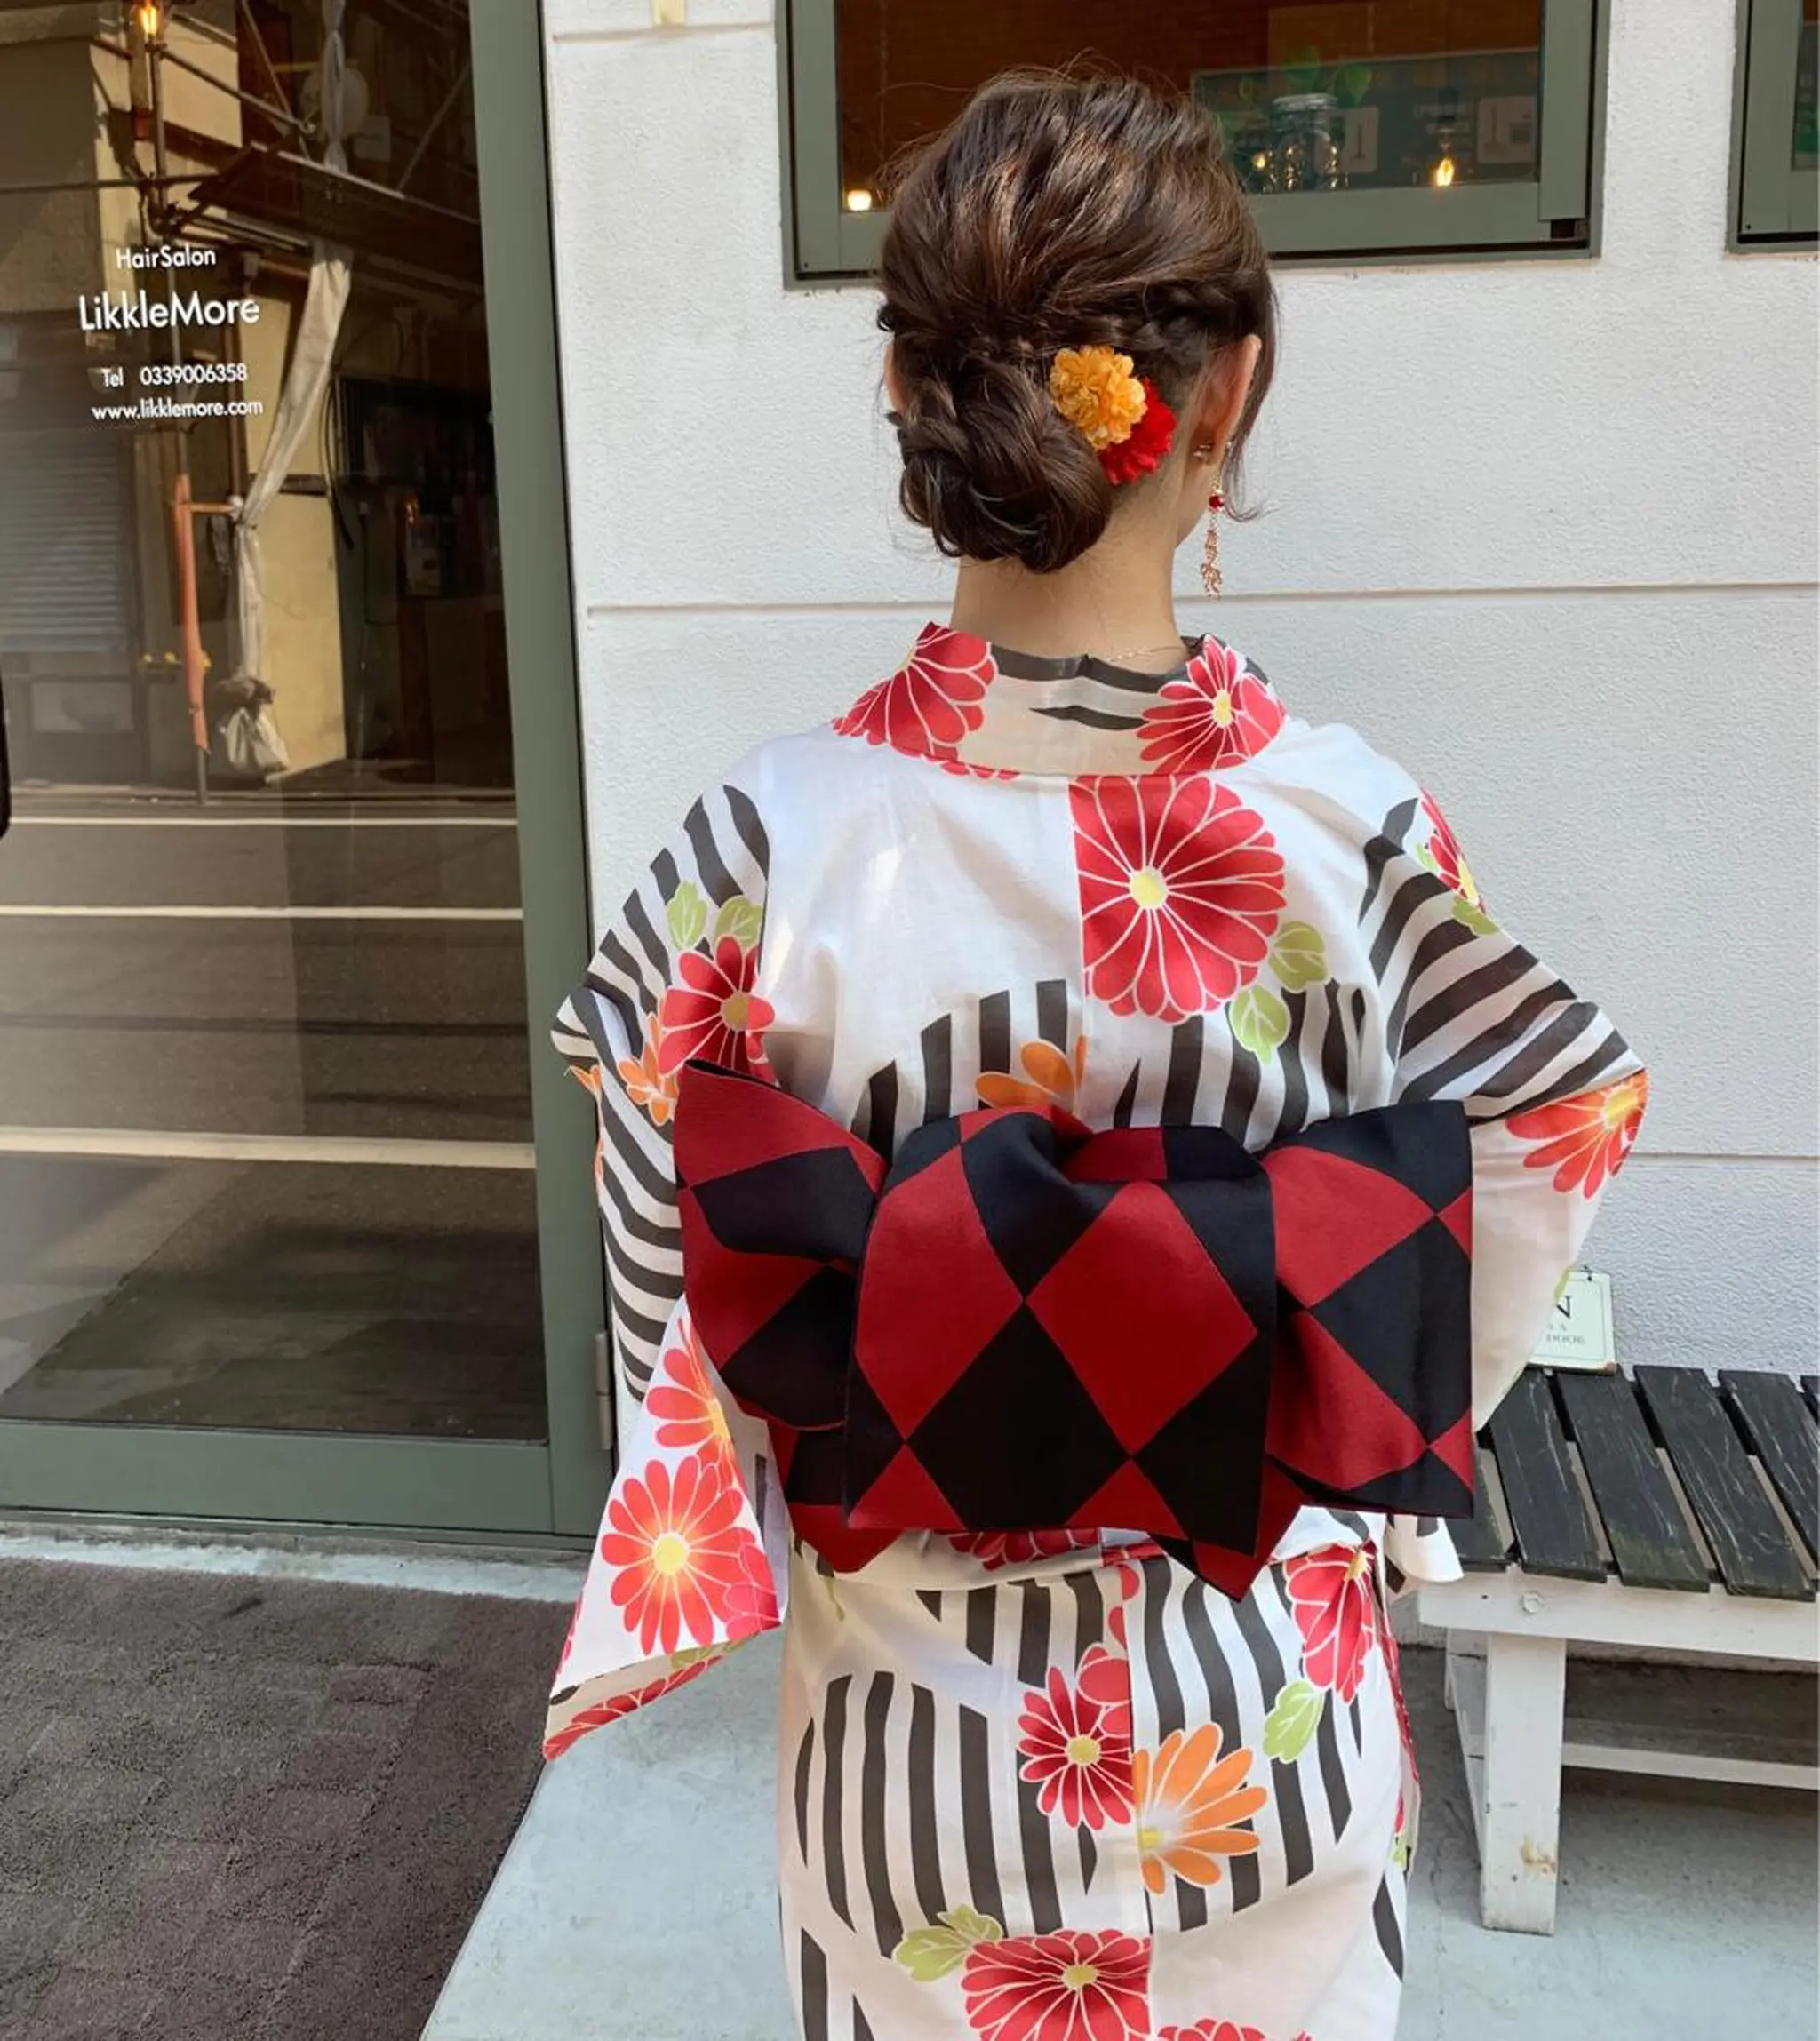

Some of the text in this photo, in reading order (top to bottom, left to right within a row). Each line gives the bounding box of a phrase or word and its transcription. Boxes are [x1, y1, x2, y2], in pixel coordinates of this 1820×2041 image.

[78, 289, 260, 331] LikkleMore
[101, 363, 248, 387] Tel 0339006358
[91, 396, 264, 420] www.likklemore.com
